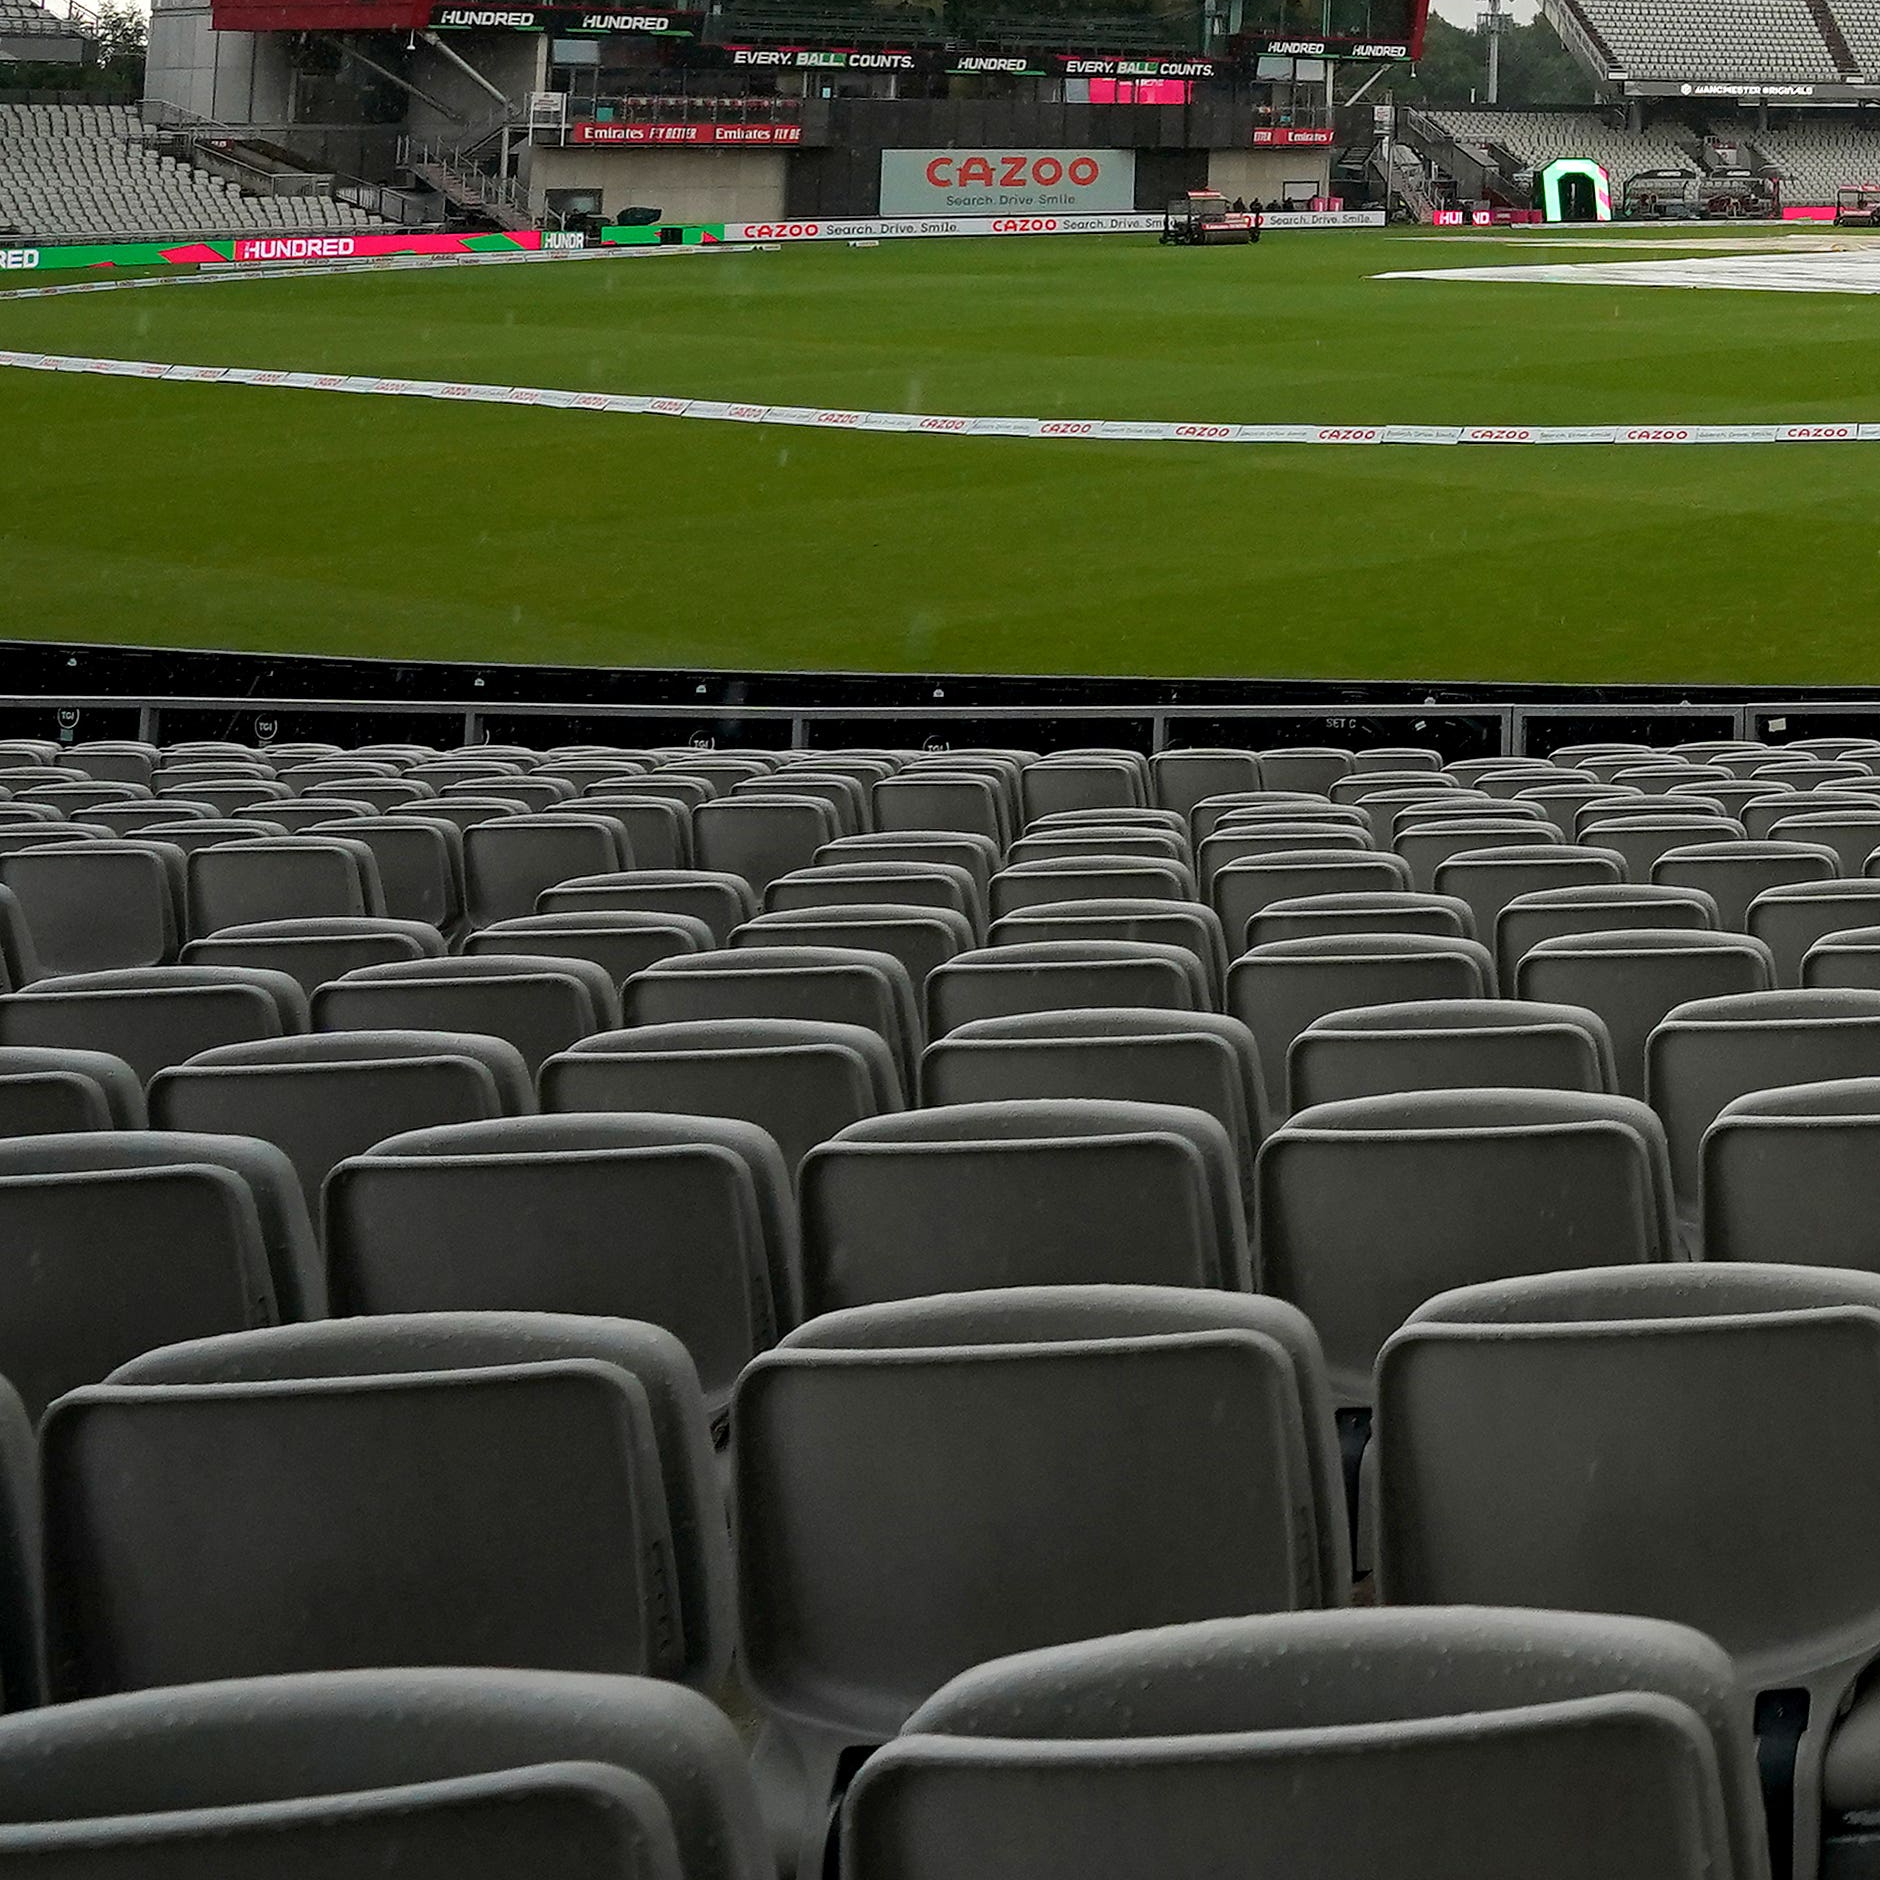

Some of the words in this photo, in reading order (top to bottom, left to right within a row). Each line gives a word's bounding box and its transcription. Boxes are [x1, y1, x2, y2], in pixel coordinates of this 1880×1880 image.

[441, 10, 534, 26] HUNDRED
[582, 14, 669, 31] HUNDRED
[1268, 42, 1325, 55] HUNDRED
[1353, 43, 1406, 58] HUNDRED
[733, 51, 792, 66] EVERY.
[849, 53, 915, 69] COUNTS.
[958, 57, 1027, 71] HUNDRED
[1066, 60, 1114, 75] EVERY.
[1160, 63, 1215, 77] COUNTS.
[584, 126, 644, 141] Emirates
[715, 127, 771, 141] Emirates
[926, 156, 1099, 188] CAZOO
[744, 224, 818, 239] CAZOO
[826, 223, 877, 237] Search.
[880, 222, 917, 235] Drive.
[992, 218, 1057, 232] CAZOO
[243, 237, 354, 259] HUNDRED
[817, 413, 858, 424] CAZOO
[919, 418, 965, 430] CAZOO
[1040, 423, 1092, 434] CAZOO
[1175, 426, 1231, 437] CAZOO
[1318, 429, 1376, 440] CAZOO
[1471, 429, 1530, 440] CAZOO
[1627, 429, 1688, 441] CAZOO
[1787, 428, 1848, 439] CAZOO
[1326, 718, 1346, 728] SET
[1349, 718, 1356, 729] C
